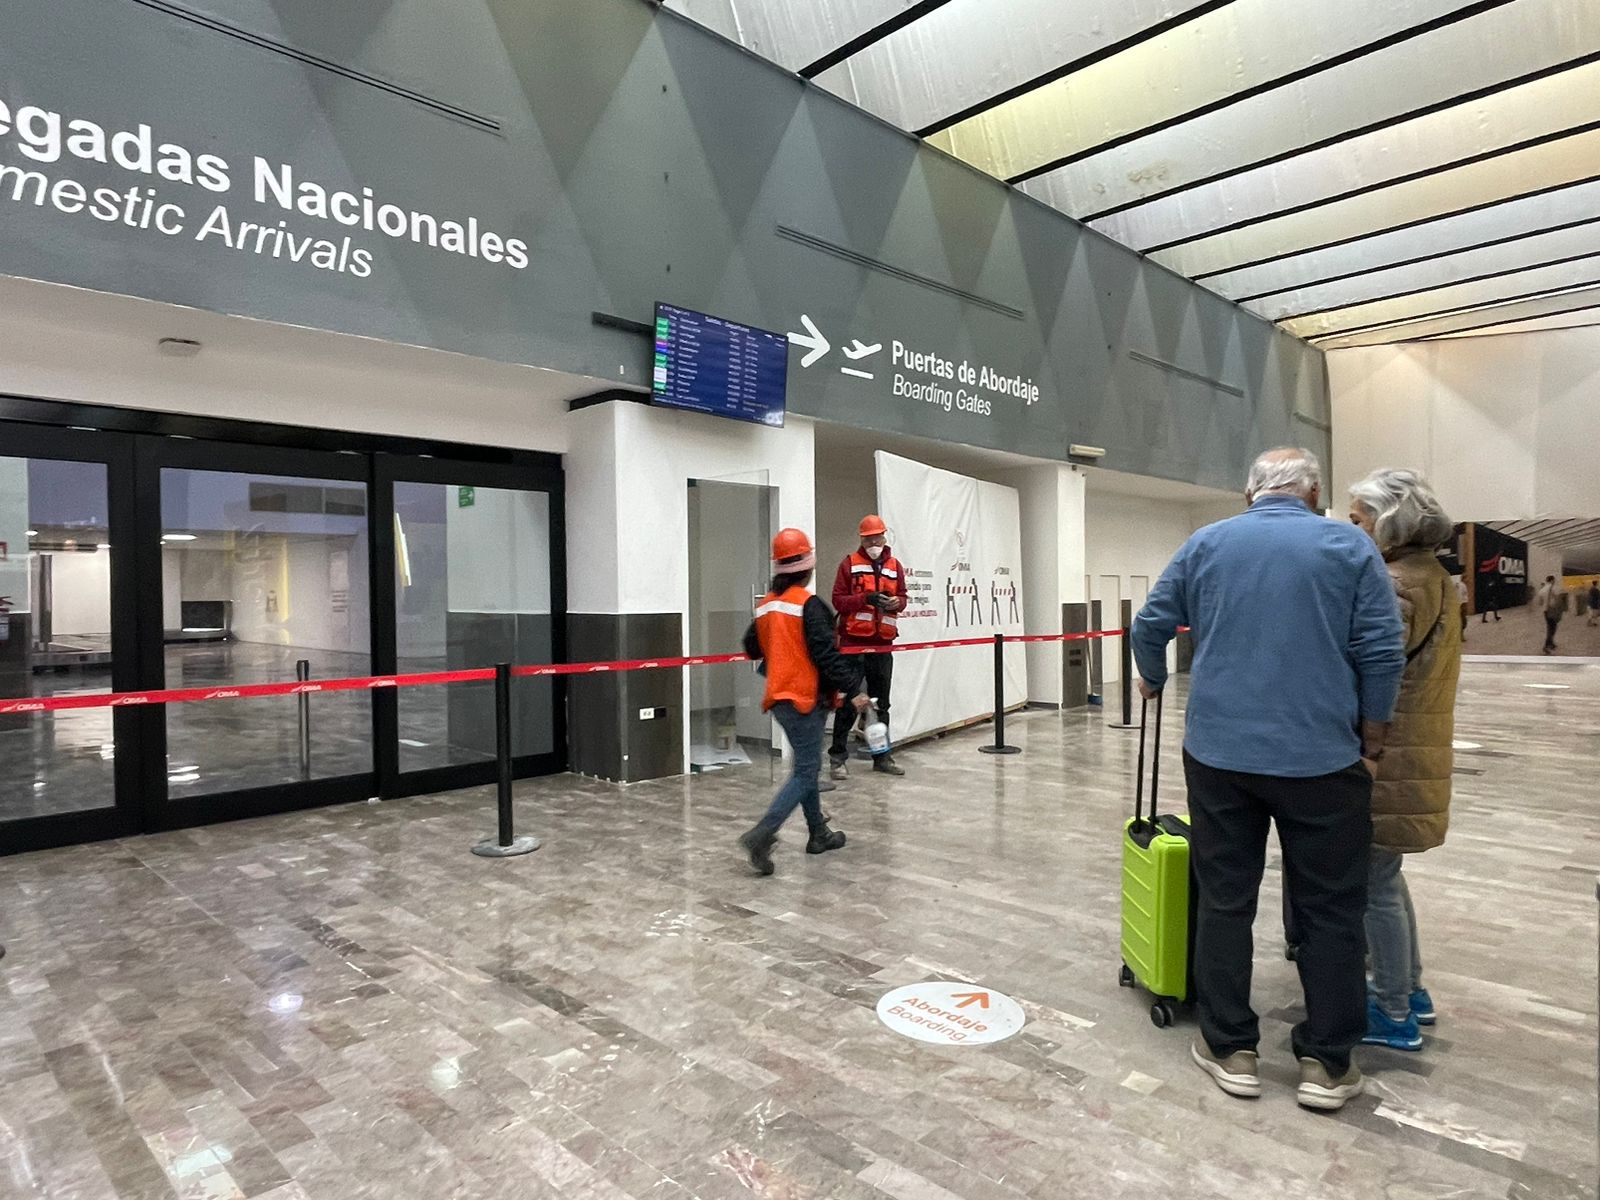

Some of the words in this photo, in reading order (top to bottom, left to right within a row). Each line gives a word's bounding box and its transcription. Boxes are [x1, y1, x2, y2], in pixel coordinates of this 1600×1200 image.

[0, 100, 230, 193] gadas
[254, 156, 529, 269] Nacionales
[195, 206, 374, 279] Arrivals
[892, 341, 954, 380] Puertas
[958, 361, 976, 386] de
[979, 366, 1039, 405] Abordaje
[893, 374, 953, 411] Boarding
[956, 389, 991, 416] Gates
[17, 703, 45, 711] OMA
[122, 696, 148, 705] OMA
[887, 1005, 968, 1042] Boarding
[902, 997, 988, 1032] Abordaje
